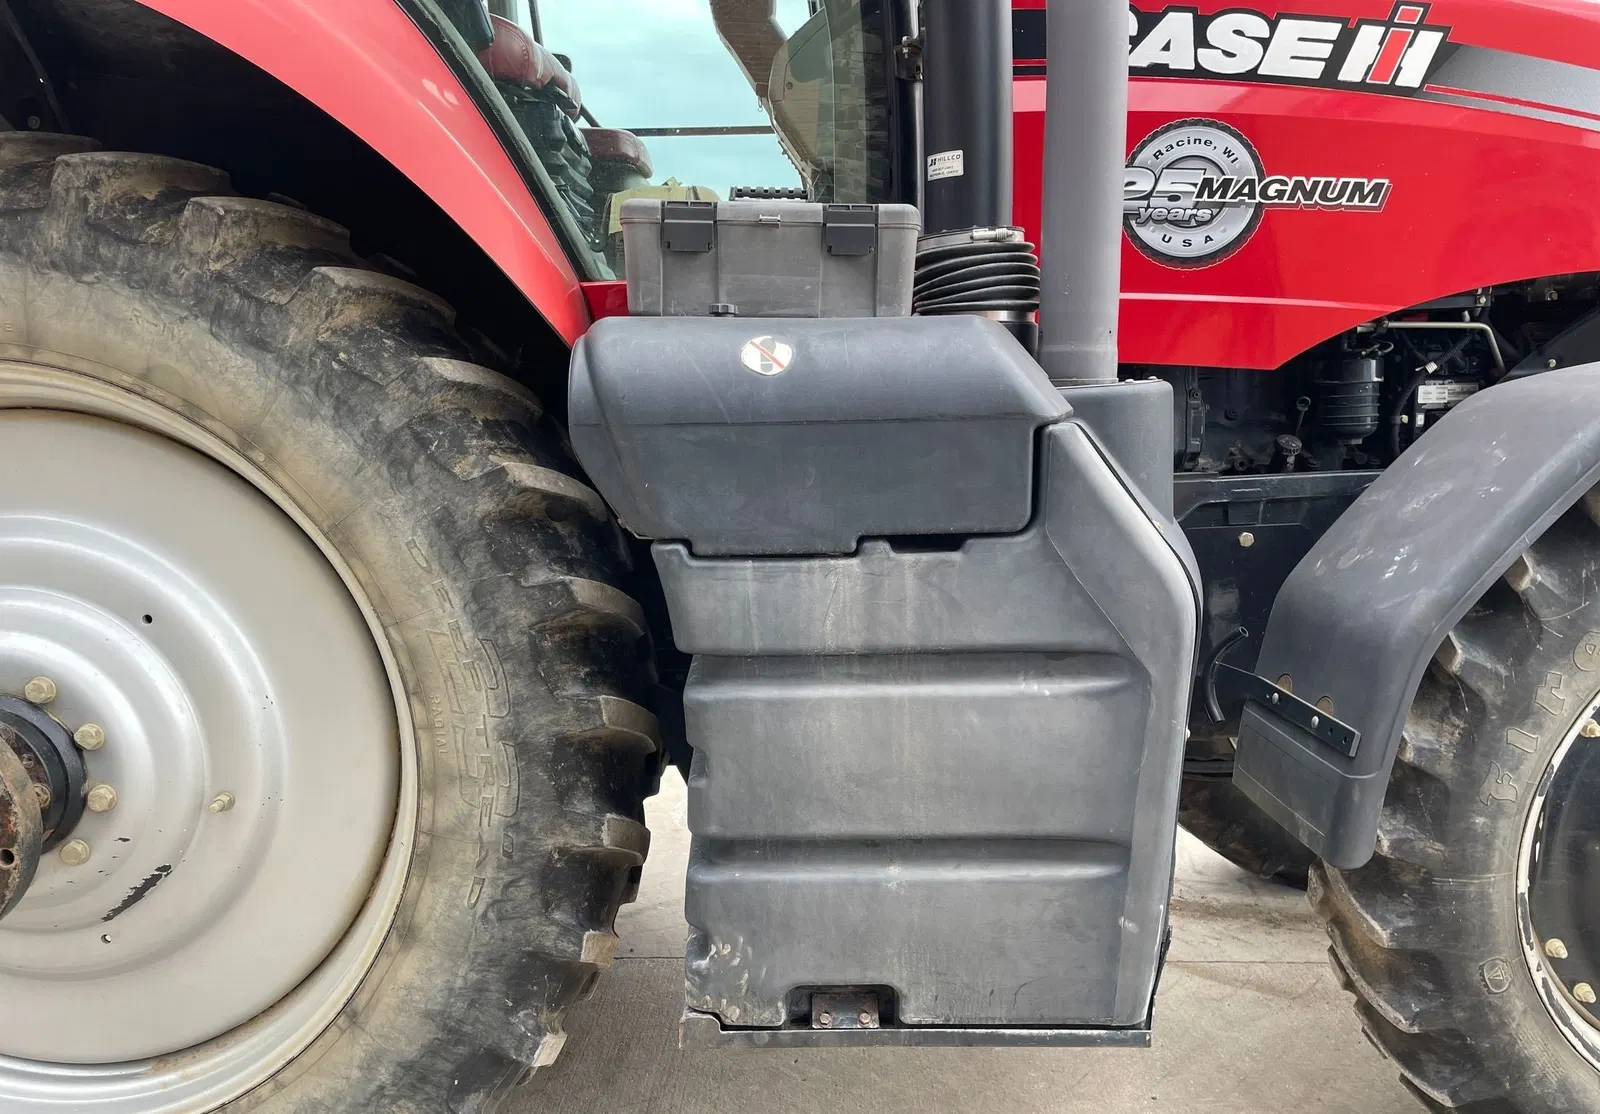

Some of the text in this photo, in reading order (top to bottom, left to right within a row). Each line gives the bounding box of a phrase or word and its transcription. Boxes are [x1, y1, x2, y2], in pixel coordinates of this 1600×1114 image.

[1128, 5, 1342, 79] ASE
[937, 154, 960, 162] HILLCO
[1153, 137, 1239, 163] Racine, WI
[1195, 176, 1391, 209] MAGNUM
[1136, 206, 1213, 226] years
[430, 695, 450, 760] RADIAL
